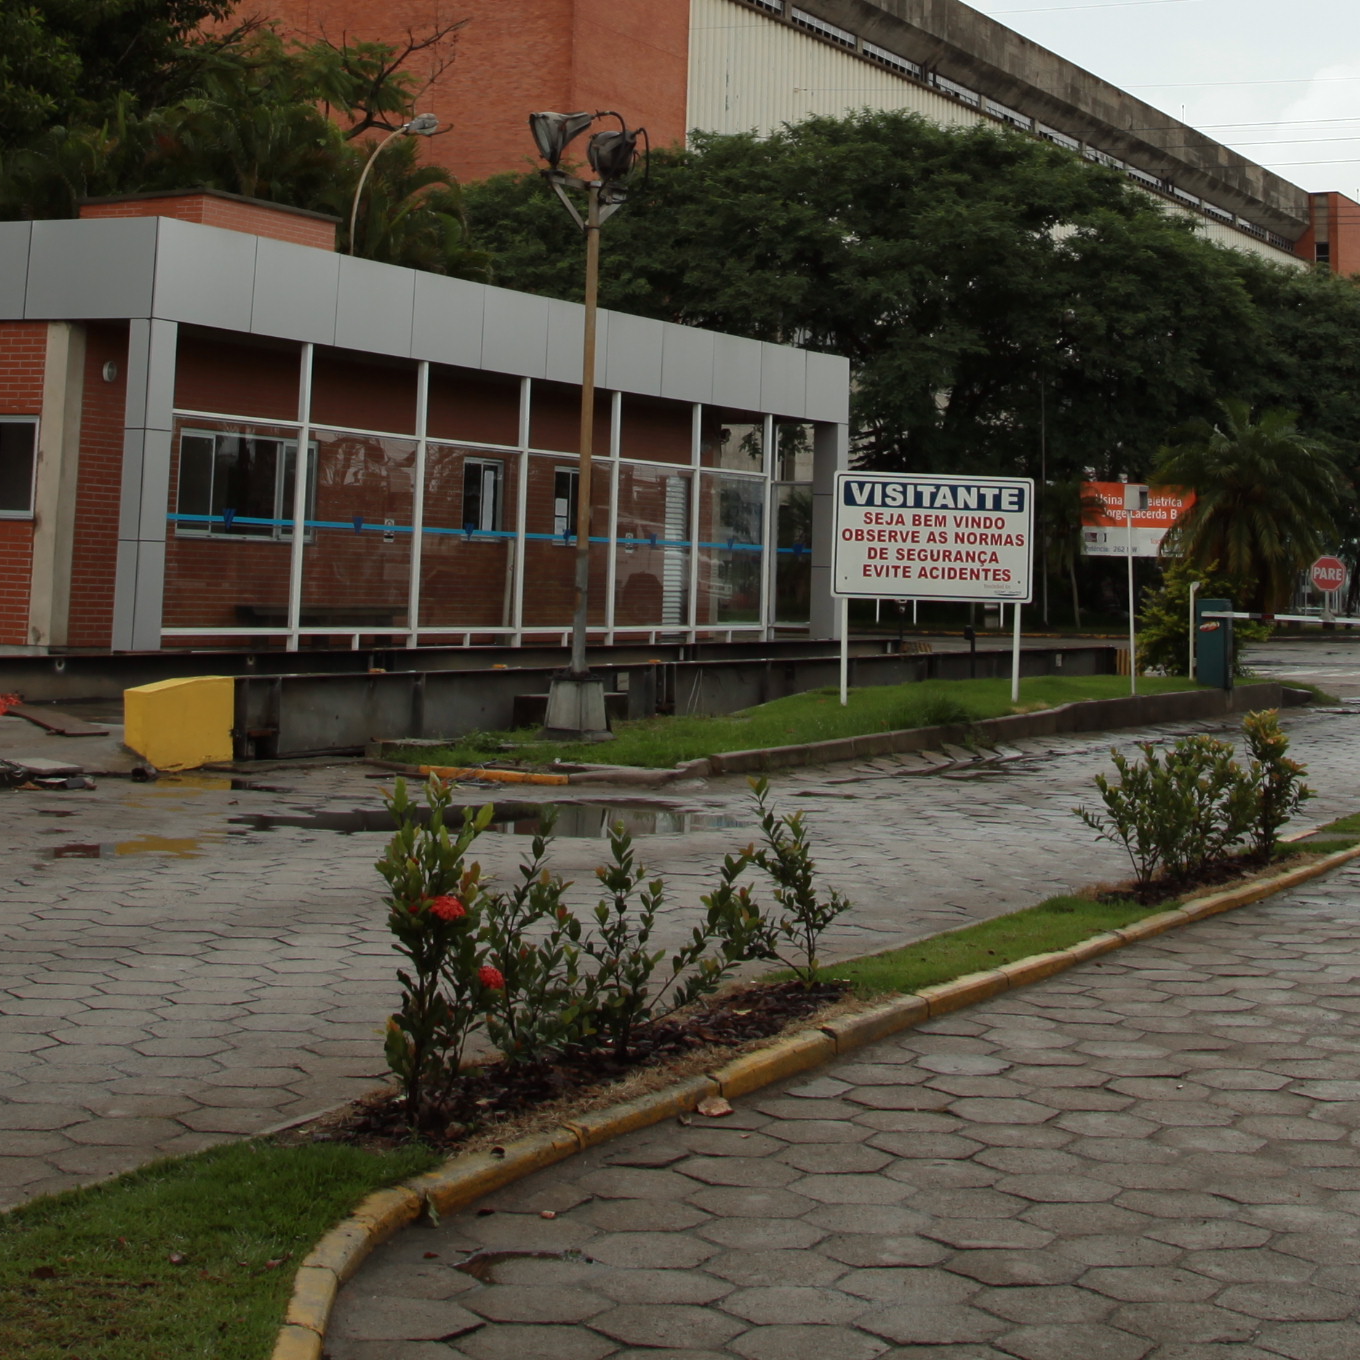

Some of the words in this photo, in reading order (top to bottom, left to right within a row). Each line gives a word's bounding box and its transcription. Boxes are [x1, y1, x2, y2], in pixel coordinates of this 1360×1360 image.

[850, 482, 1019, 511] VISITANTE
[863, 511, 906, 526] SEJA
[912, 513, 947, 528] BEM
[953, 515, 1006, 530] VINDO
[1130, 509, 1167, 520] Lacerda
[842, 528, 921, 544] OBSERVE
[926, 531, 948, 544] AS
[954, 532, 1025, 547] NORMAS
[867, 547, 889, 560] DE
[895, 548, 999, 567] SEGURANÇA
[862, 564, 912, 579] EVITE
[917, 566, 1011, 582] ACIDENTES
[1313, 567, 1342, 581] PARE
